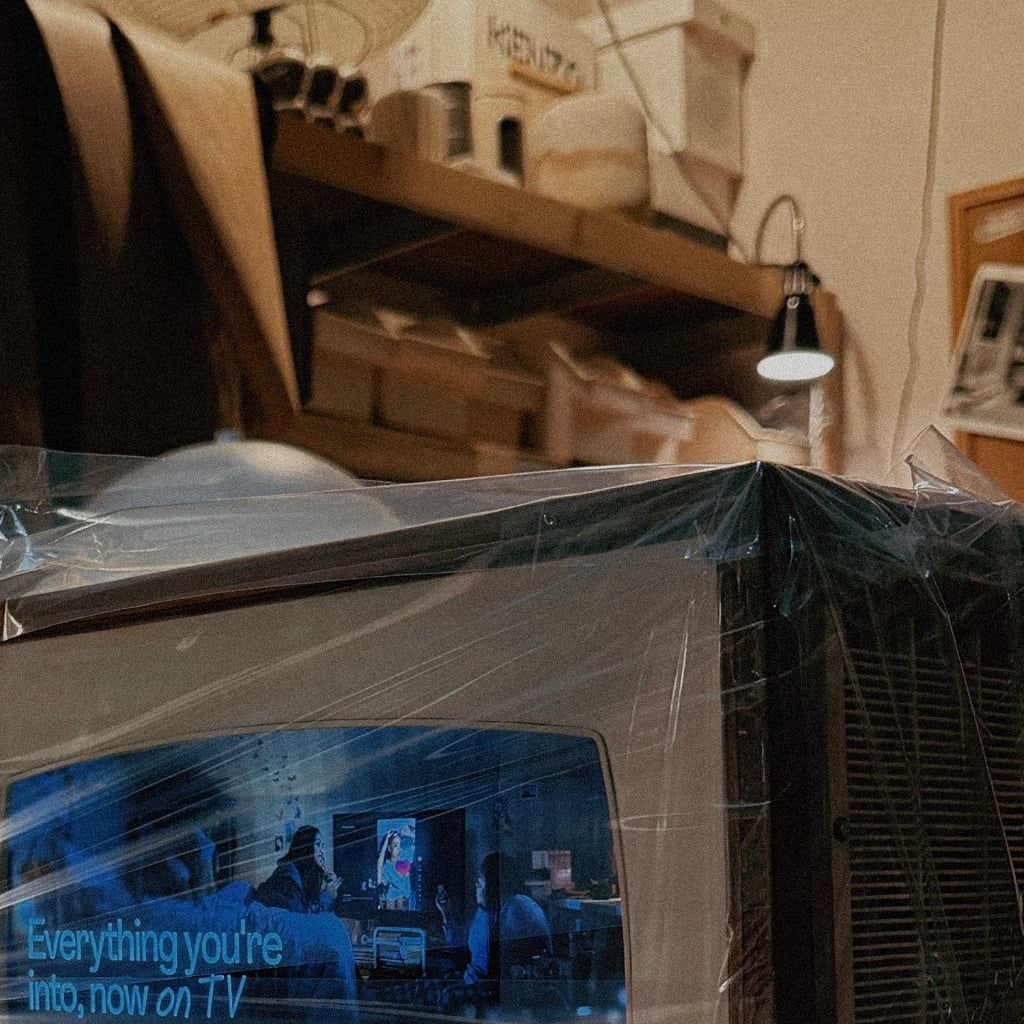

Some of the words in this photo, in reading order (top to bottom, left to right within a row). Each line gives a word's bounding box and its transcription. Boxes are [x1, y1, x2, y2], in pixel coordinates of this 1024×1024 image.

[28, 917, 177, 976] Everything
[184, 919, 283, 976] you're
[28, 969, 84, 1019] into,
[90, 982, 149, 1016] now
[156, 985, 191, 1018] on
[198, 974, 247, 1018] TV
